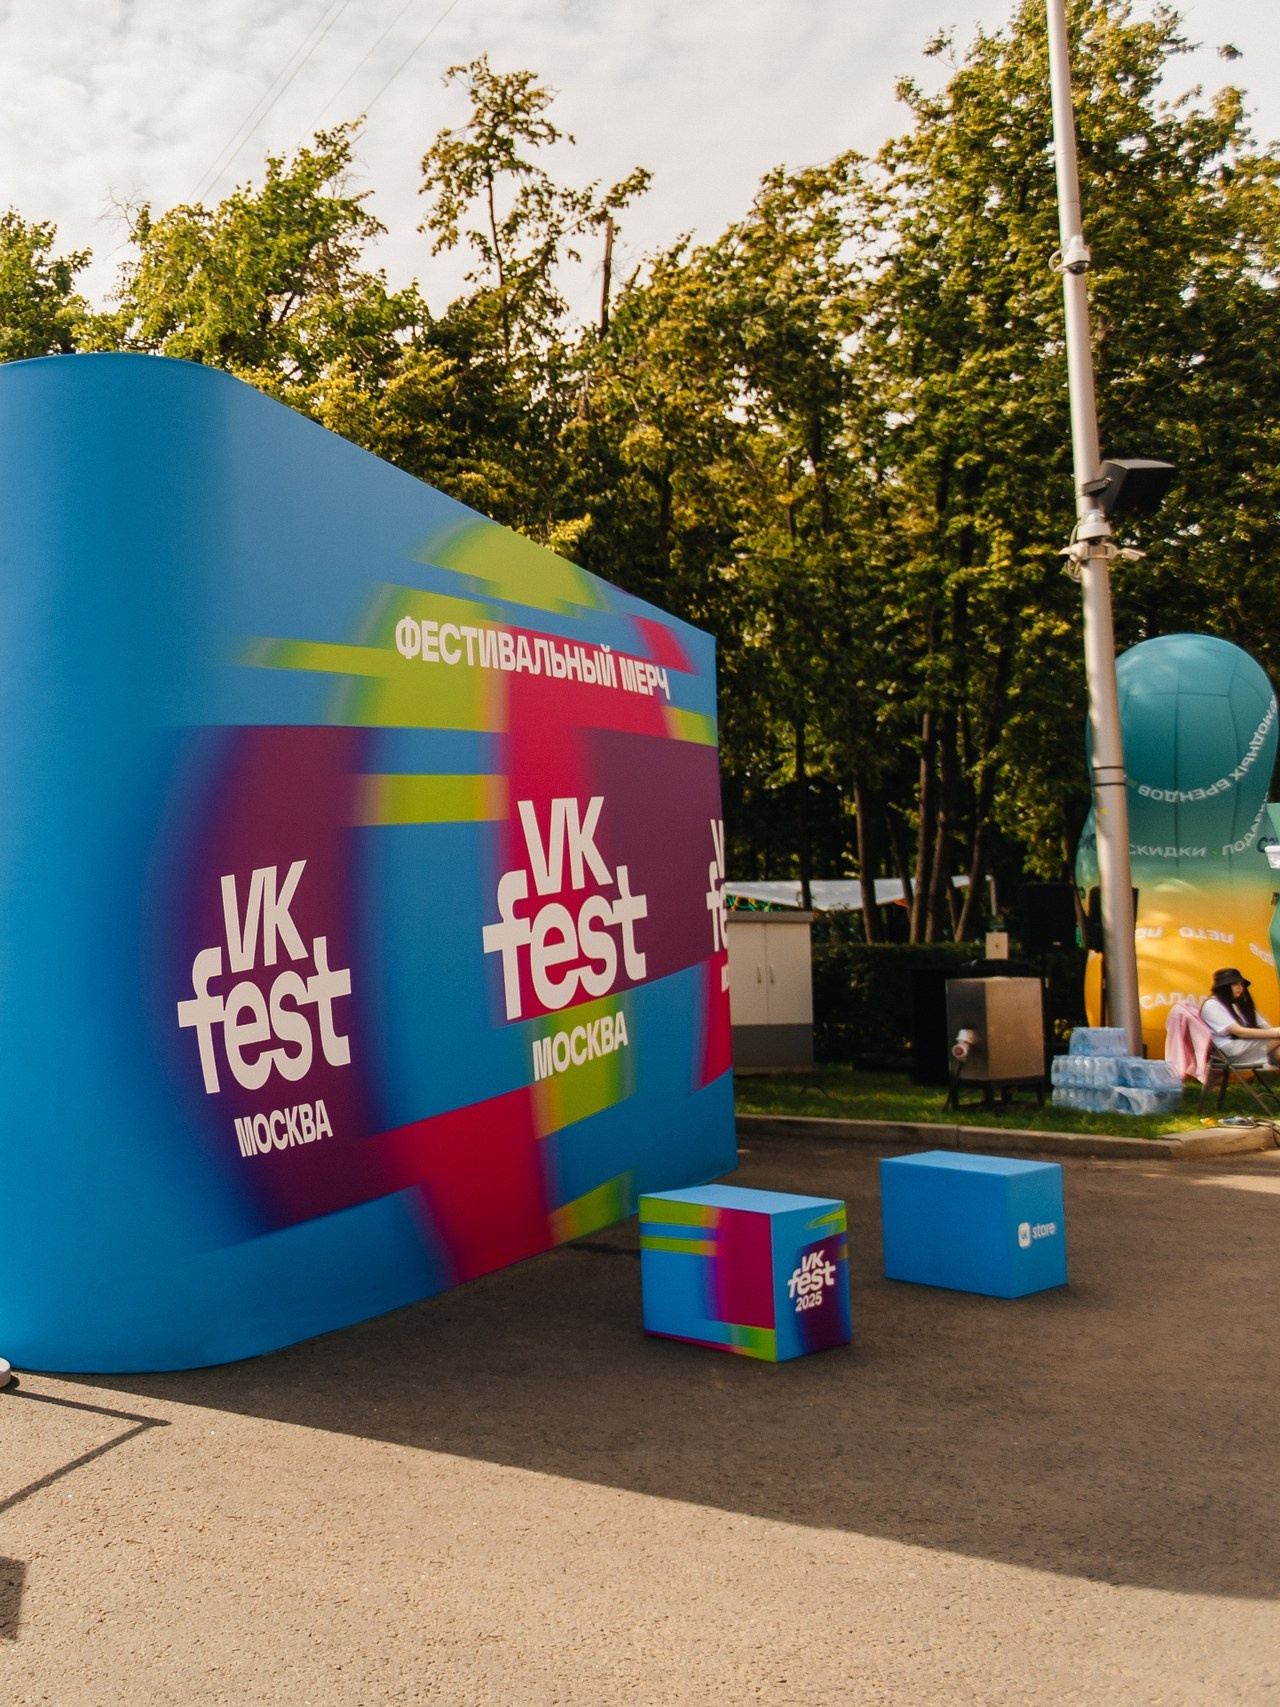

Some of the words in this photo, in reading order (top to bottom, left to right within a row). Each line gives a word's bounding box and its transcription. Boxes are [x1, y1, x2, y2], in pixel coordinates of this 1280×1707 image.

[395, 616, 618, 689] ФЕСТИВАЛЬНЫЙ
[618, 656, 671, 700] МЕРЧ
[1137, 778, 1231, 803] БРЕНДОВ
[517, 796, 614, 896] VK
[710, 818, 725, 879] V
[220, 859, 309, 973] VK
[482, 865, 648, 1021] fest
[1179, 926, 1235, 944] ЛЕТО
[177, 935, 352, 1095] fest
[532, 1011, 629, 1081] МОСКВА
[234, 1099, 333, 1157] МОСКВА
[1031, 1222, 1056, 1240] store
[787, 1260, 837, 1299] fest
[801, 1250, 825, 1273] VK
[795, 1291, 823, 1312] 2025
